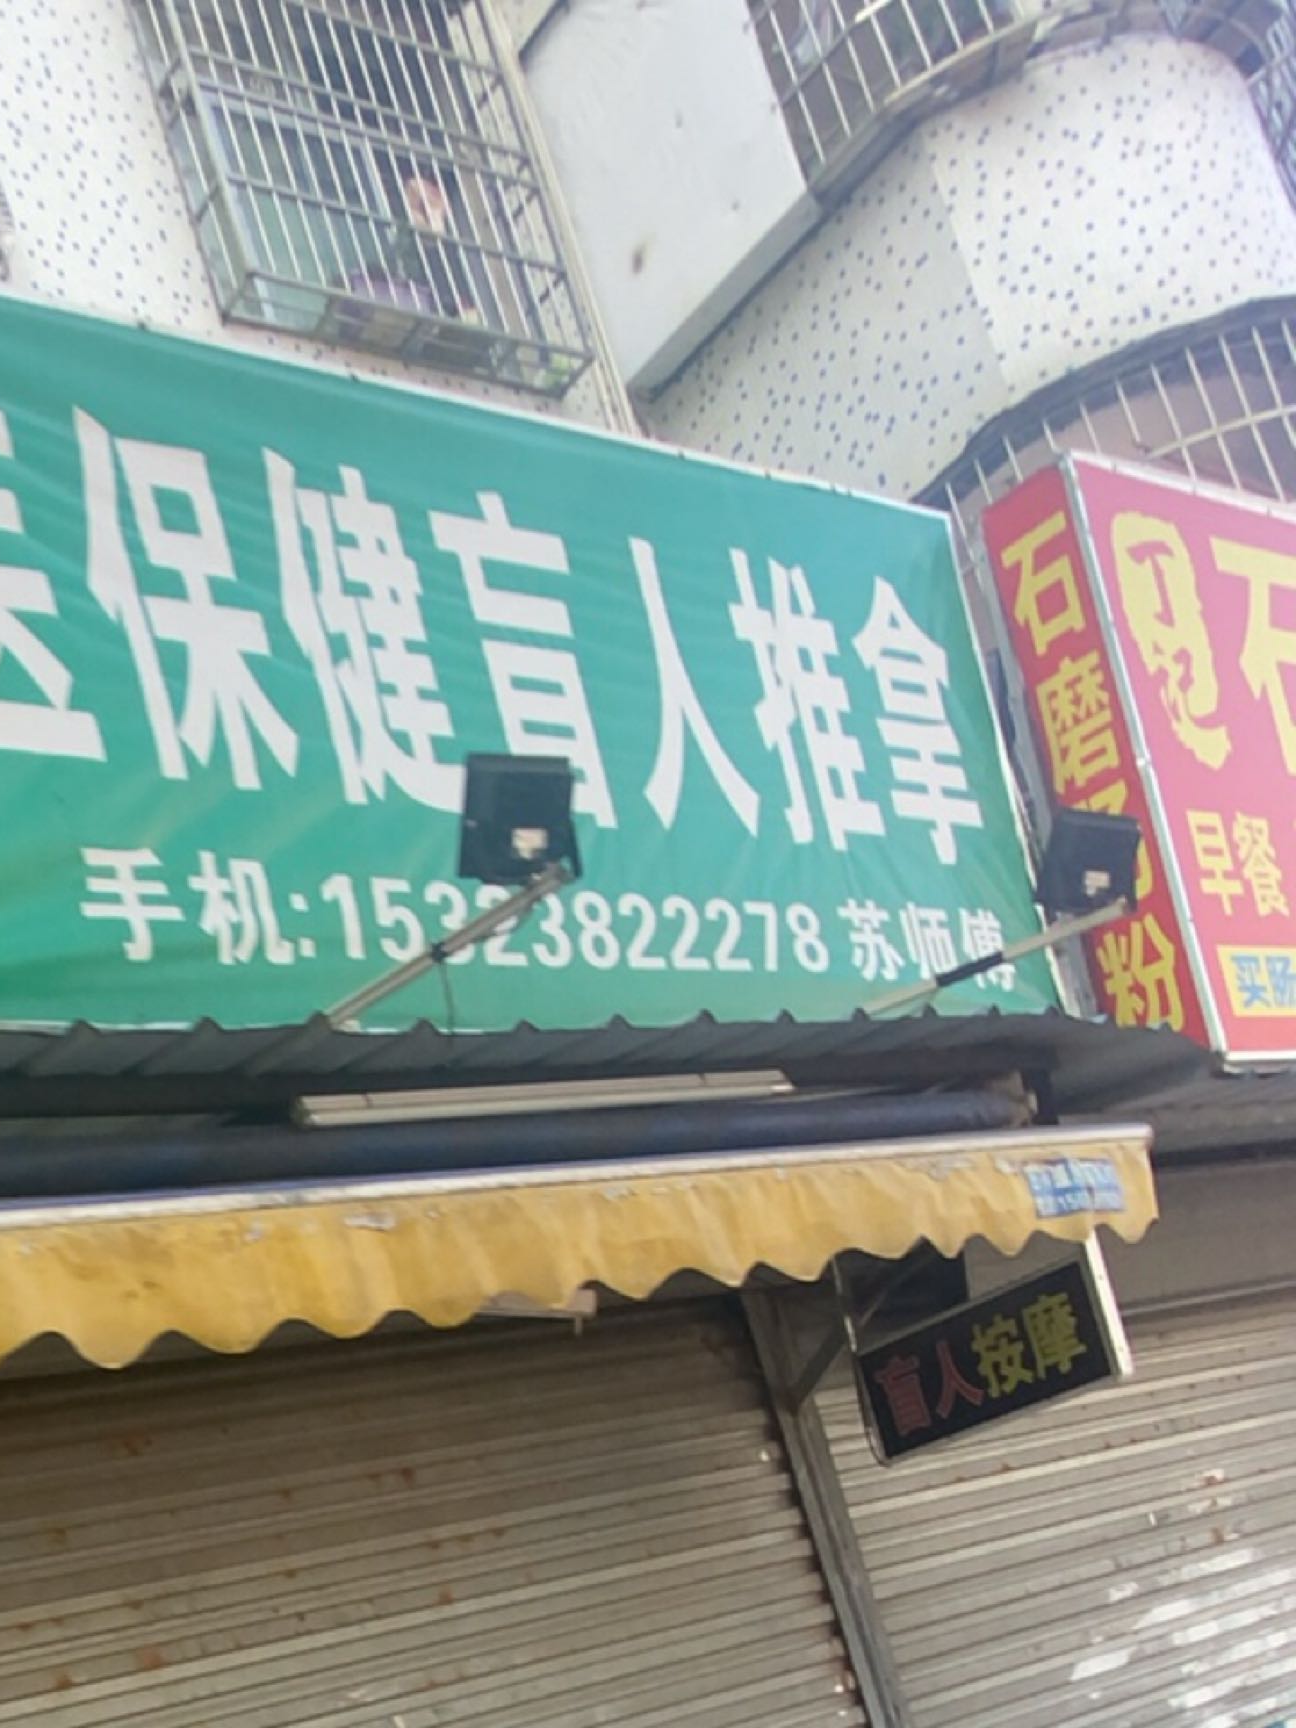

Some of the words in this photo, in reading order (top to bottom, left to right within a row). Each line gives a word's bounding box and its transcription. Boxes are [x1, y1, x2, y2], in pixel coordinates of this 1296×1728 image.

[1001, 511, 1184, 1032] 石磨粉
[873, 1292, 1089, 1437] 盲人按摩
